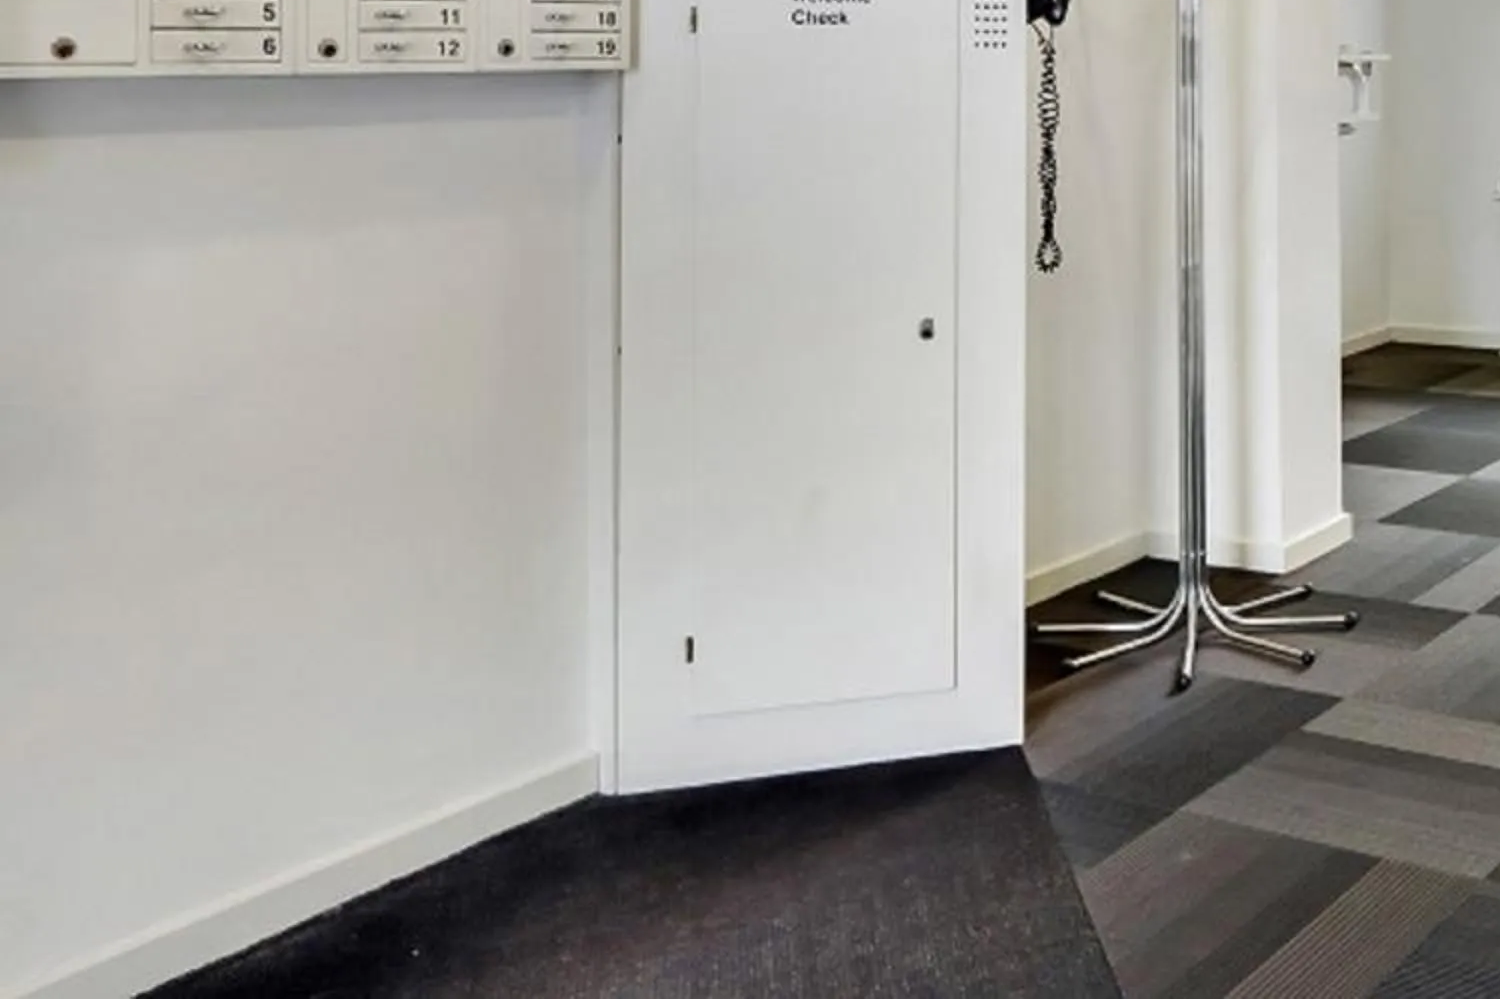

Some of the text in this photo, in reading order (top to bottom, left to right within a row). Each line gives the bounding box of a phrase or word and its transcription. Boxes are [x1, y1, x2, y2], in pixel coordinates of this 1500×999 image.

[263, 3, 277, 22] 5
[441, 8, 461, 25] 11
[598, 11, 617, 27] 18
[791, 8, 849, 26] Check
[263, 37, 277, 56] 6
[438, 38, 461, 56] 12
[597, 38, 617, 55] 19
